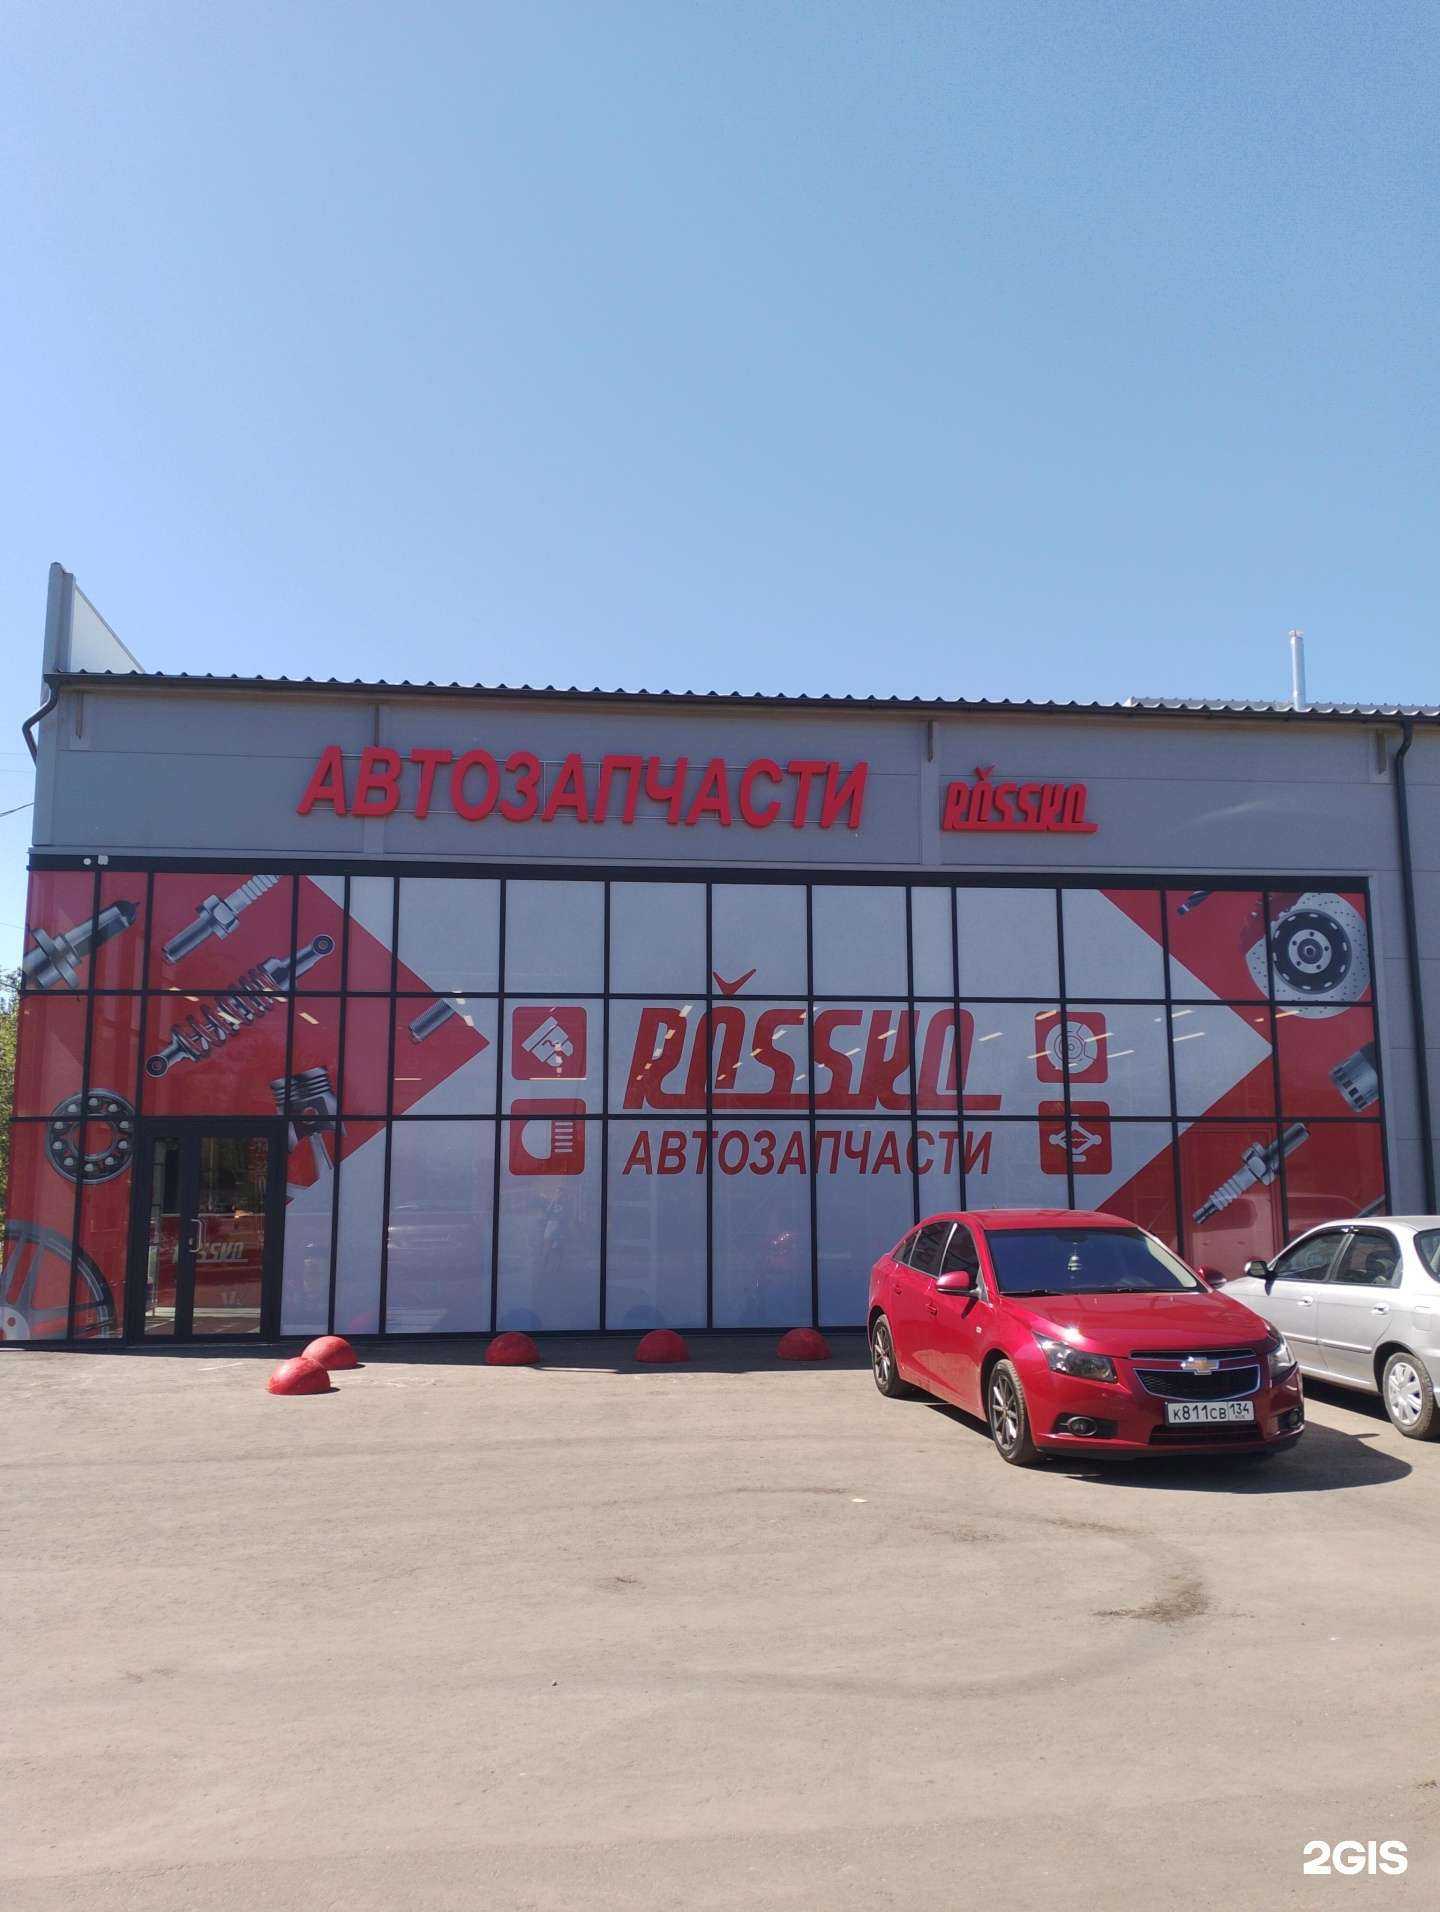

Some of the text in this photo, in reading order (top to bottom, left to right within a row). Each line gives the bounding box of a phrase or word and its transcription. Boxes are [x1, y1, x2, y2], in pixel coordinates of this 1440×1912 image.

[297, 745, 868, 830] АВТОЗАПЧАСТИ
[942, 765, 1098, 832] ROSSKO
[622, 969, 1002, 1111] ROSSKO
[622, 1129, 994, 1176] АВТОЗАПЧАСТИ
